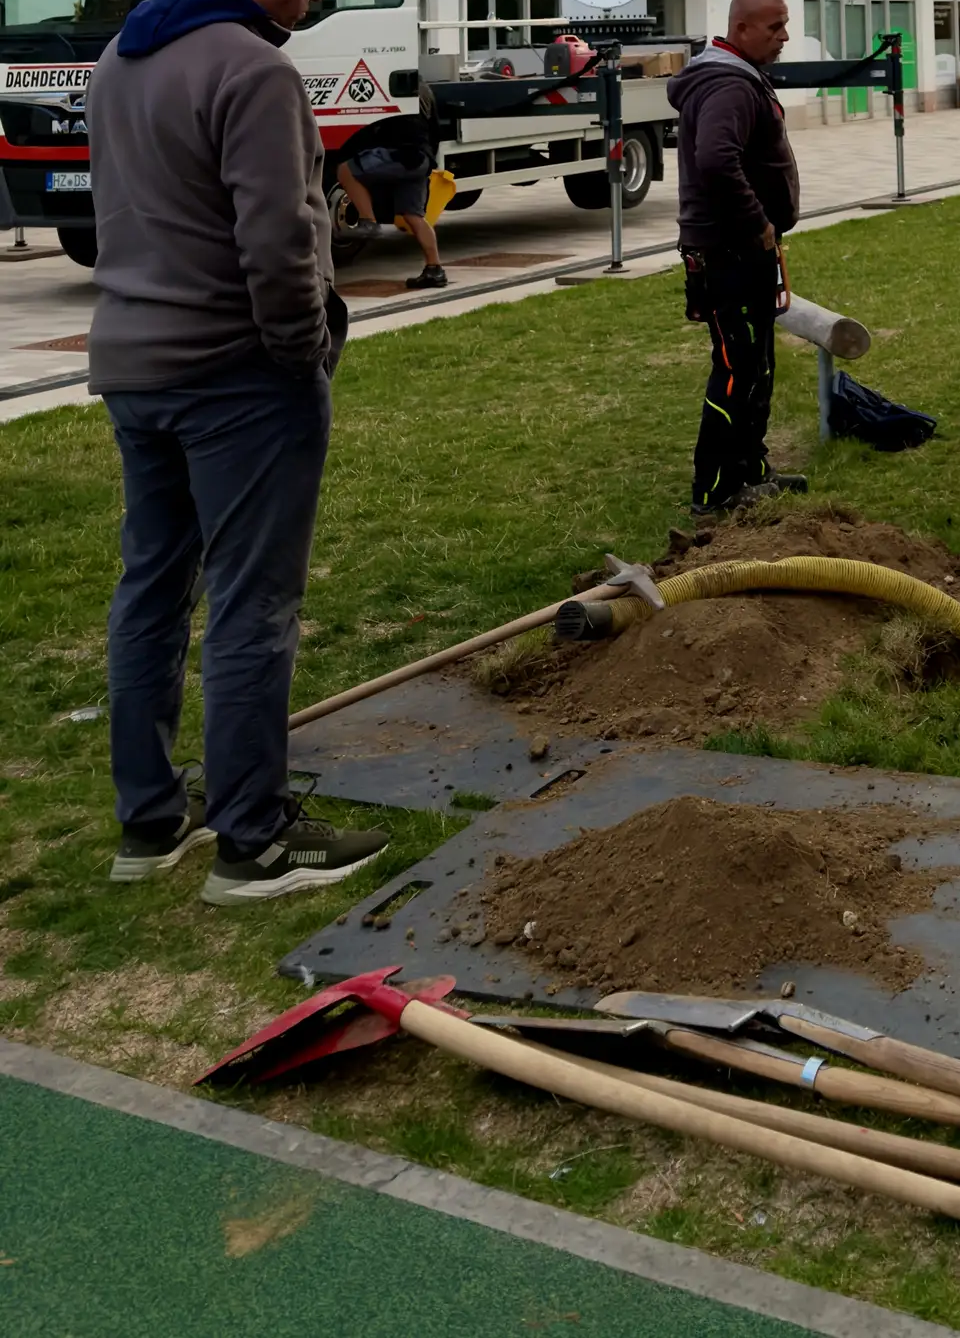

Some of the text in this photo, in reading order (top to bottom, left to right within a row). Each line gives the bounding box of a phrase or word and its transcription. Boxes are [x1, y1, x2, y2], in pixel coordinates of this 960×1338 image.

[302, 77, 339, 89] ECKER
[307, 90, 332, 105] ZE
[51, 120, 88, 134] MA
[288, 850, 327, 864] PUMA
